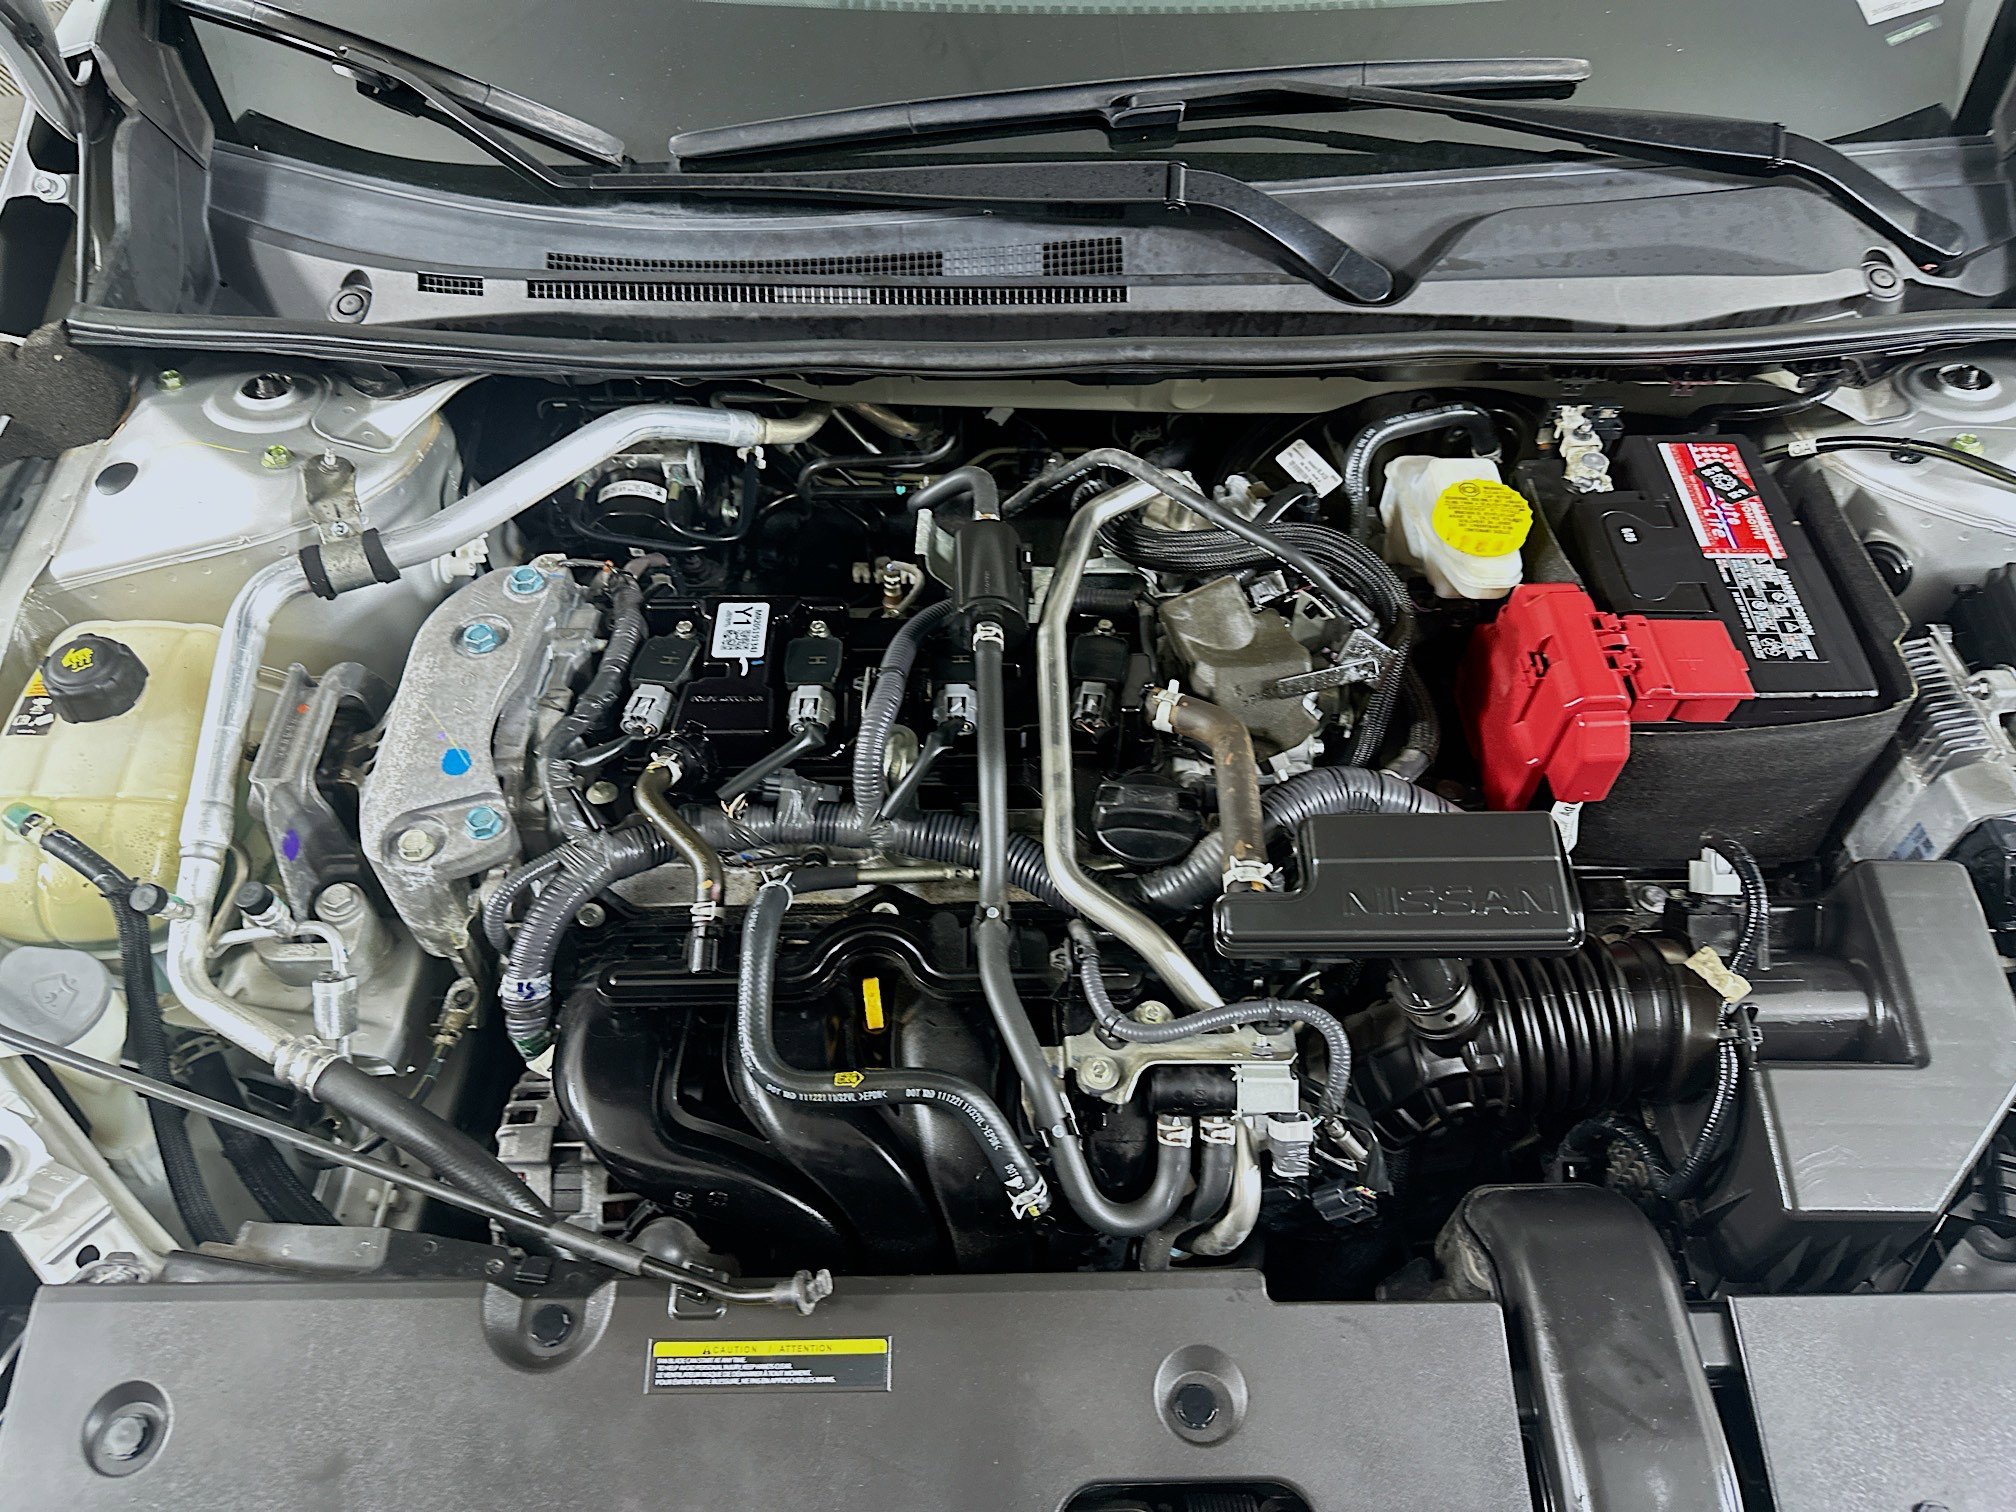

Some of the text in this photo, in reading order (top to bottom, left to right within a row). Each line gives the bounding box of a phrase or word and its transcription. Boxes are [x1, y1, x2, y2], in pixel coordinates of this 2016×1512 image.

[732, 606, 754, 626] Y1
[1343, 884, 1559, 918] NISSAN
[712, 1345, 758, 1355] CAUTION
[778, 1343, 833, 1353] ATTENTION
